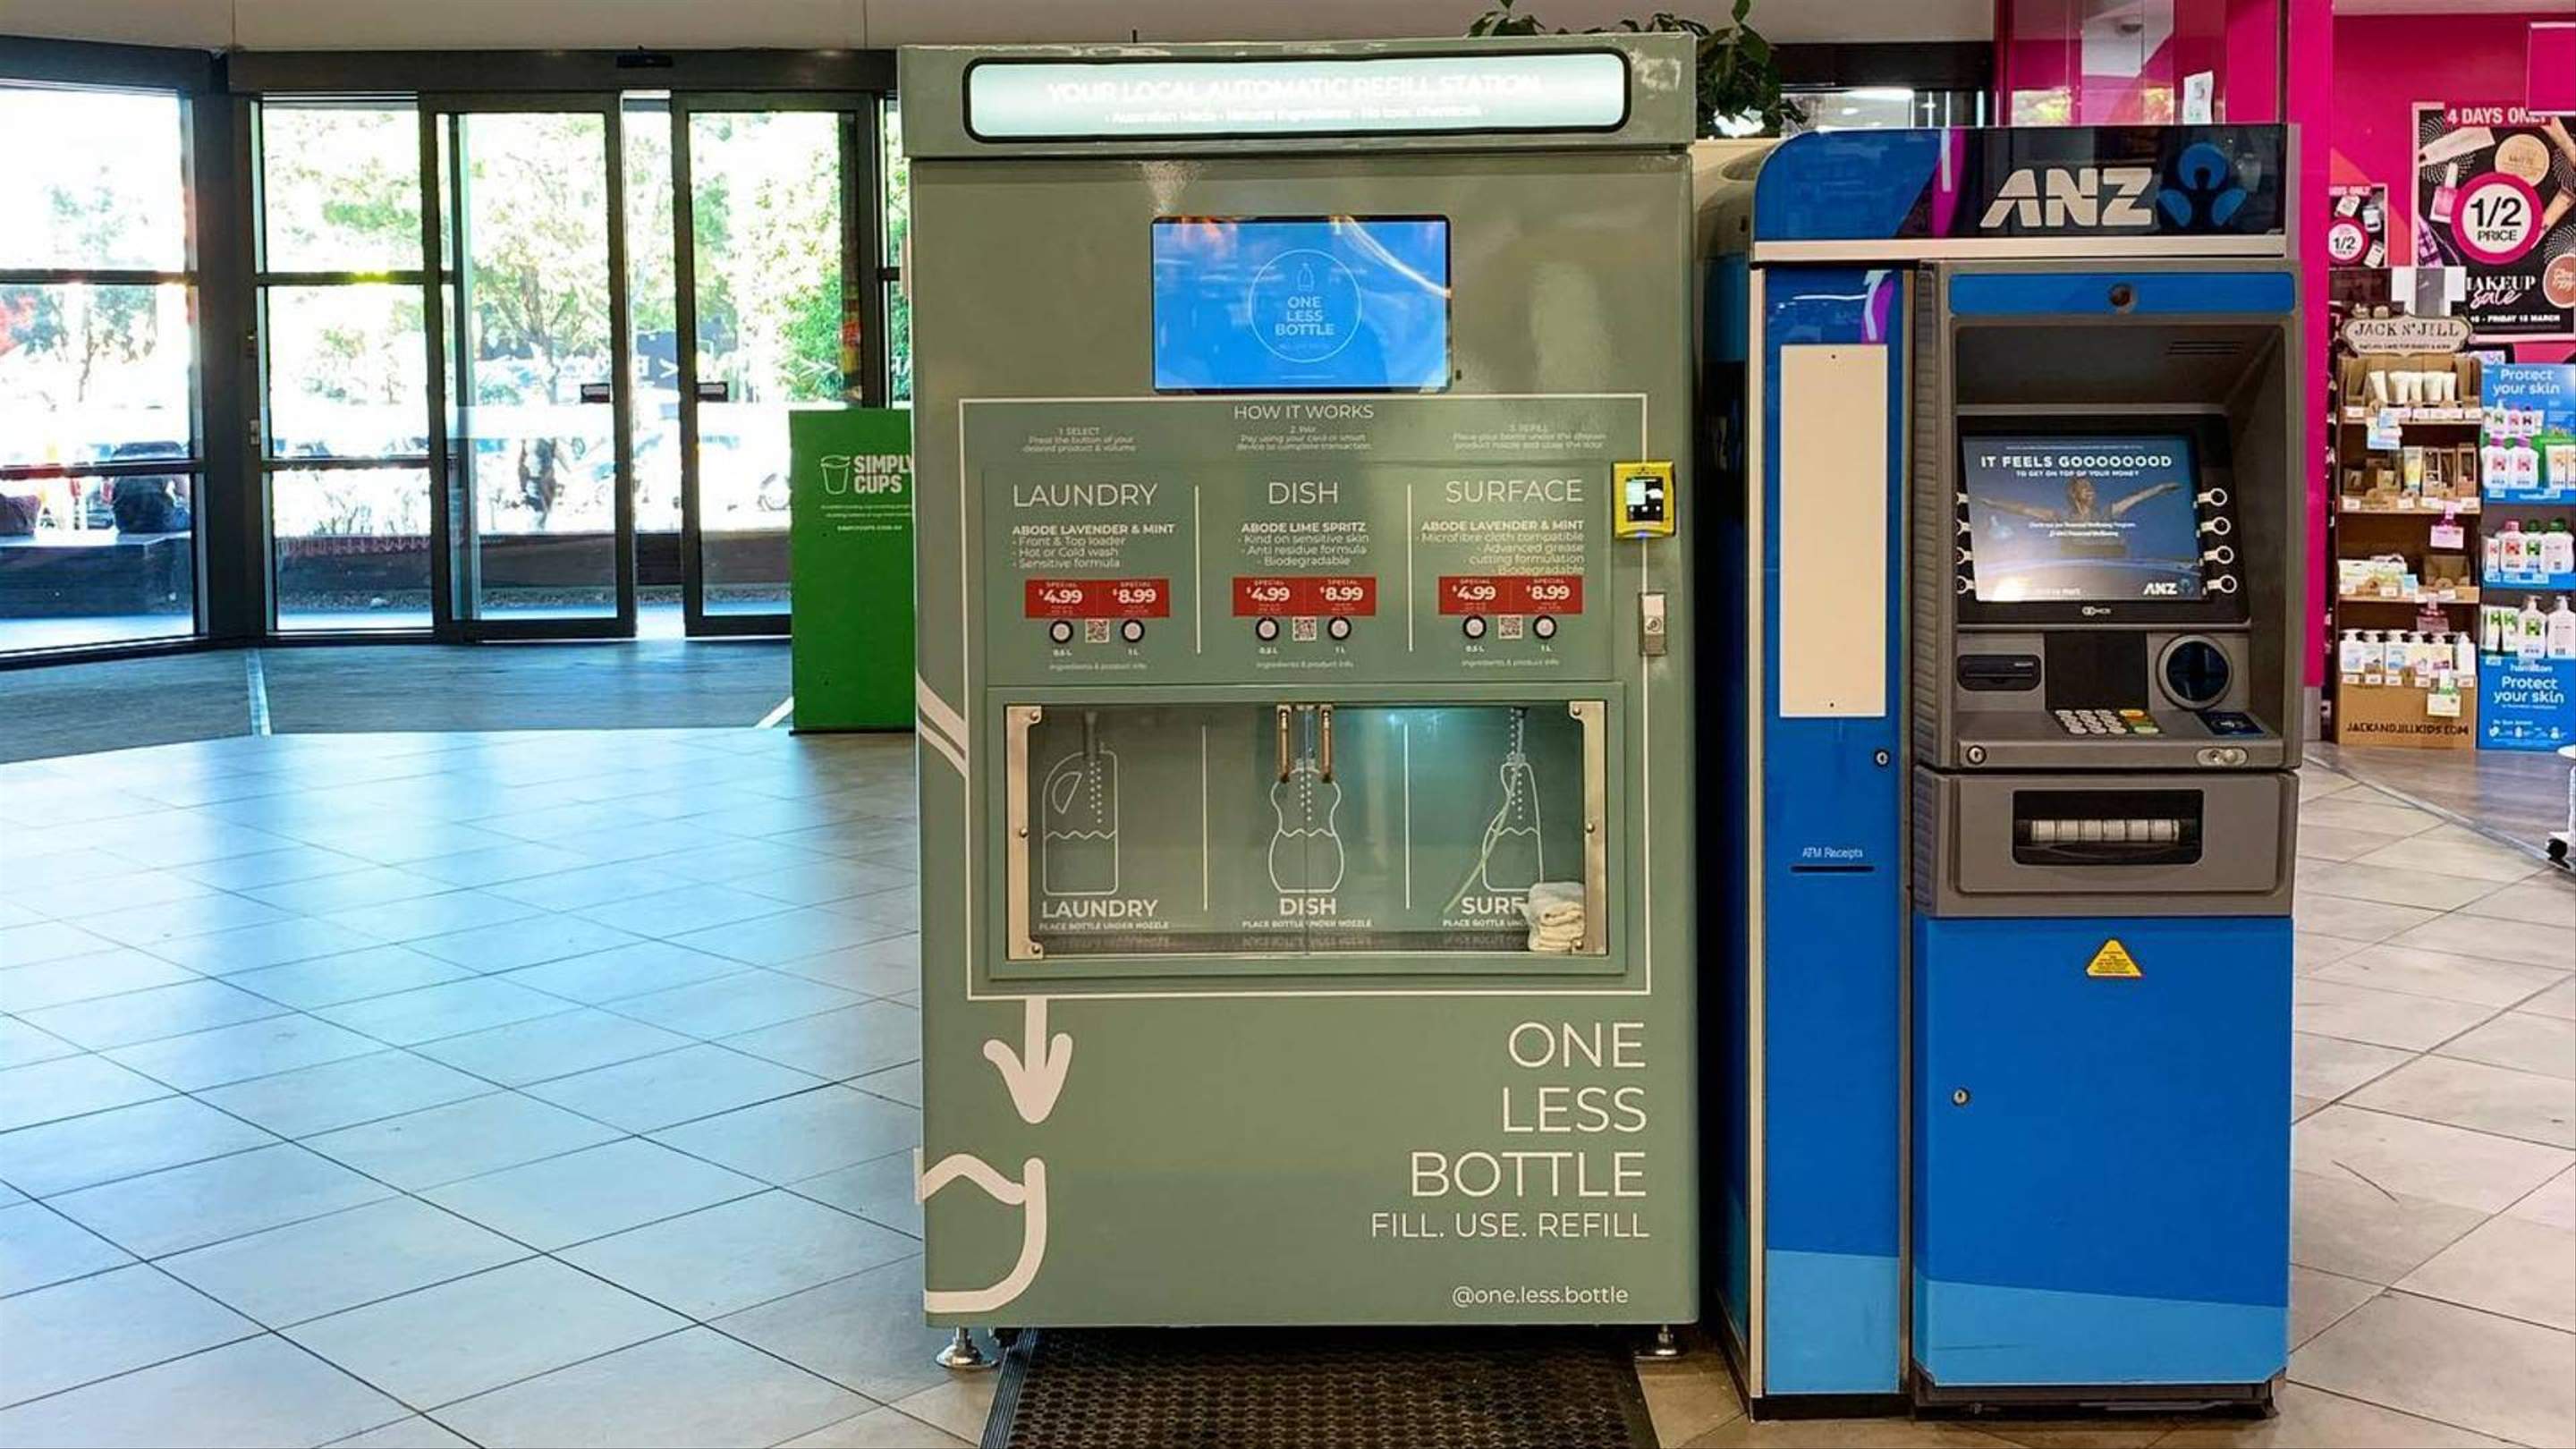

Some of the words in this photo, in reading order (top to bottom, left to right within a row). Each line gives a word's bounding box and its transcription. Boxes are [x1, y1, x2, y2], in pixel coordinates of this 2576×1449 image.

[2447, 107, 2458, 124] 4
[2462, 106, 2504, 124] DAYS
[1979, 166, 2153, 229] ANZ
[2470, 196, 2521, 228] 1/2
[2334, 236, 2356, 250] 1/2
[2477, 229, 2518, 242] PRICE
[1287, 295, 1321, 309] ONE
[2470, 288, 2522, 309] sale
[1286, 309, 1323, 322] LESS
[1275, 323, 1335, 336] BOTTLE
[2354, 323, 2397, 336] JACK
[2417, 323, 2459, 336] JILL
[2500, 369, 2555, 381] Protect
[2493, 384, 2525, 397] your
[2529, 382, 2560, 394] skin
[1234, 405, 1281, 419] HOW
[1286, 405, 1301, 419] IT
[1305, 404, 1375, 419] WORKS
[853, 453, 914, 474] SIMPLY
[1980, 455, 1996, 468] IT
[2002, 455, 2053, 468] FEELS
[853, 474, 902, 495] CUPS
[1445, 479, 1585, 504] SURFACE
[1013, 483, 1158, 507] LAUNDRY
[1268, 481, 1339, 504] DISH
[1012, 525, 1056, 536] ABODE
[1061, 525, 1129, 535] LAVENDER
[1131, 525, 1140, 535] &
[1143, 524, 1176, 534] MINT
[1241, 523, 1286, 534] ABODE
[1289, 522, 1320, 533] LIME
[1322, 522, 1367, 532] SPRITZ
[1421, 521, 1467, 532] ABODE
[1470, 521, 1538, 531] LAVENDER
[1540, 521, 1549, 530] &
[1552, 521, 1585, 530] MINT
[1019, 537, 1051, 546] Front
[1065, 537, 1086, 547] Top
[1088, 537, 1126, 546] loader
[1244, 535, 1272, 544] Kind
[1274, 536, 1290, 544] on
[1292, 534, 1343, 544] sensitive
[1345, 534, 1369, 543] skin
[1019, 547, 1041, 557] Hot
[1043, 549, 1055, 557] or
[1058, 547, 1085, 556] Cold
[1087, 547, 1119, 556] wash
[1246, 546, 1272, 555] Anti
[1275, 546, 1318, 555] residue
[1320, 546, 1367, 555] formula
[1483, 543, 1543, 553] Advanced
[1546, 544, 1585, 555] grease
[1019, 558, 1072, 568] Sensitive
[1073, 558, 1120, 568] formula
[1264, 556, 1351, 568] Biodegradable
[1038, 589, 1083, 604] $4.99
[1113, 588, 1157, 604] $8.99
[1246, 587, 1291, 602] $4.99
[1319, 587, 1364, 601] $8.99
[1452, 585, 1496, 600] $4.99
[1526, 585, 1570, 600] $8.99
[2143, 582, 2178, 596] ANZ
[2501, 675, 2559, 690] Protect
[2494, 691, 2528, 705] your
[2531, 690, 2564, 704] skin
[1042, 899, 1158, 919] LAUNDRY
[1279, 897, 1336, 916] DISH
[1462, 896, 1525, 915] SURF
[1039, 922, 1066, 931] PLACE
[1069, 922, 1101, 930] BOTTLE
[1242, 919, 1269, 928] PLACE
[1272, 919, 1303, 928] BOTTLE
[1508, 1021, 1646, 1069] ONE
[1503, 1086, 1648, 1133] LESS
[1411, 1151, 1647, 1198] BOTTLE
[1371, 1213, 1445, 1238] FILL.
[1455, 1213, 1528, 1238] USE.
[1538, 1213, 1650, 1238] REFILL
[1452, 1285, 1629, 1308] @one.less.bottle
